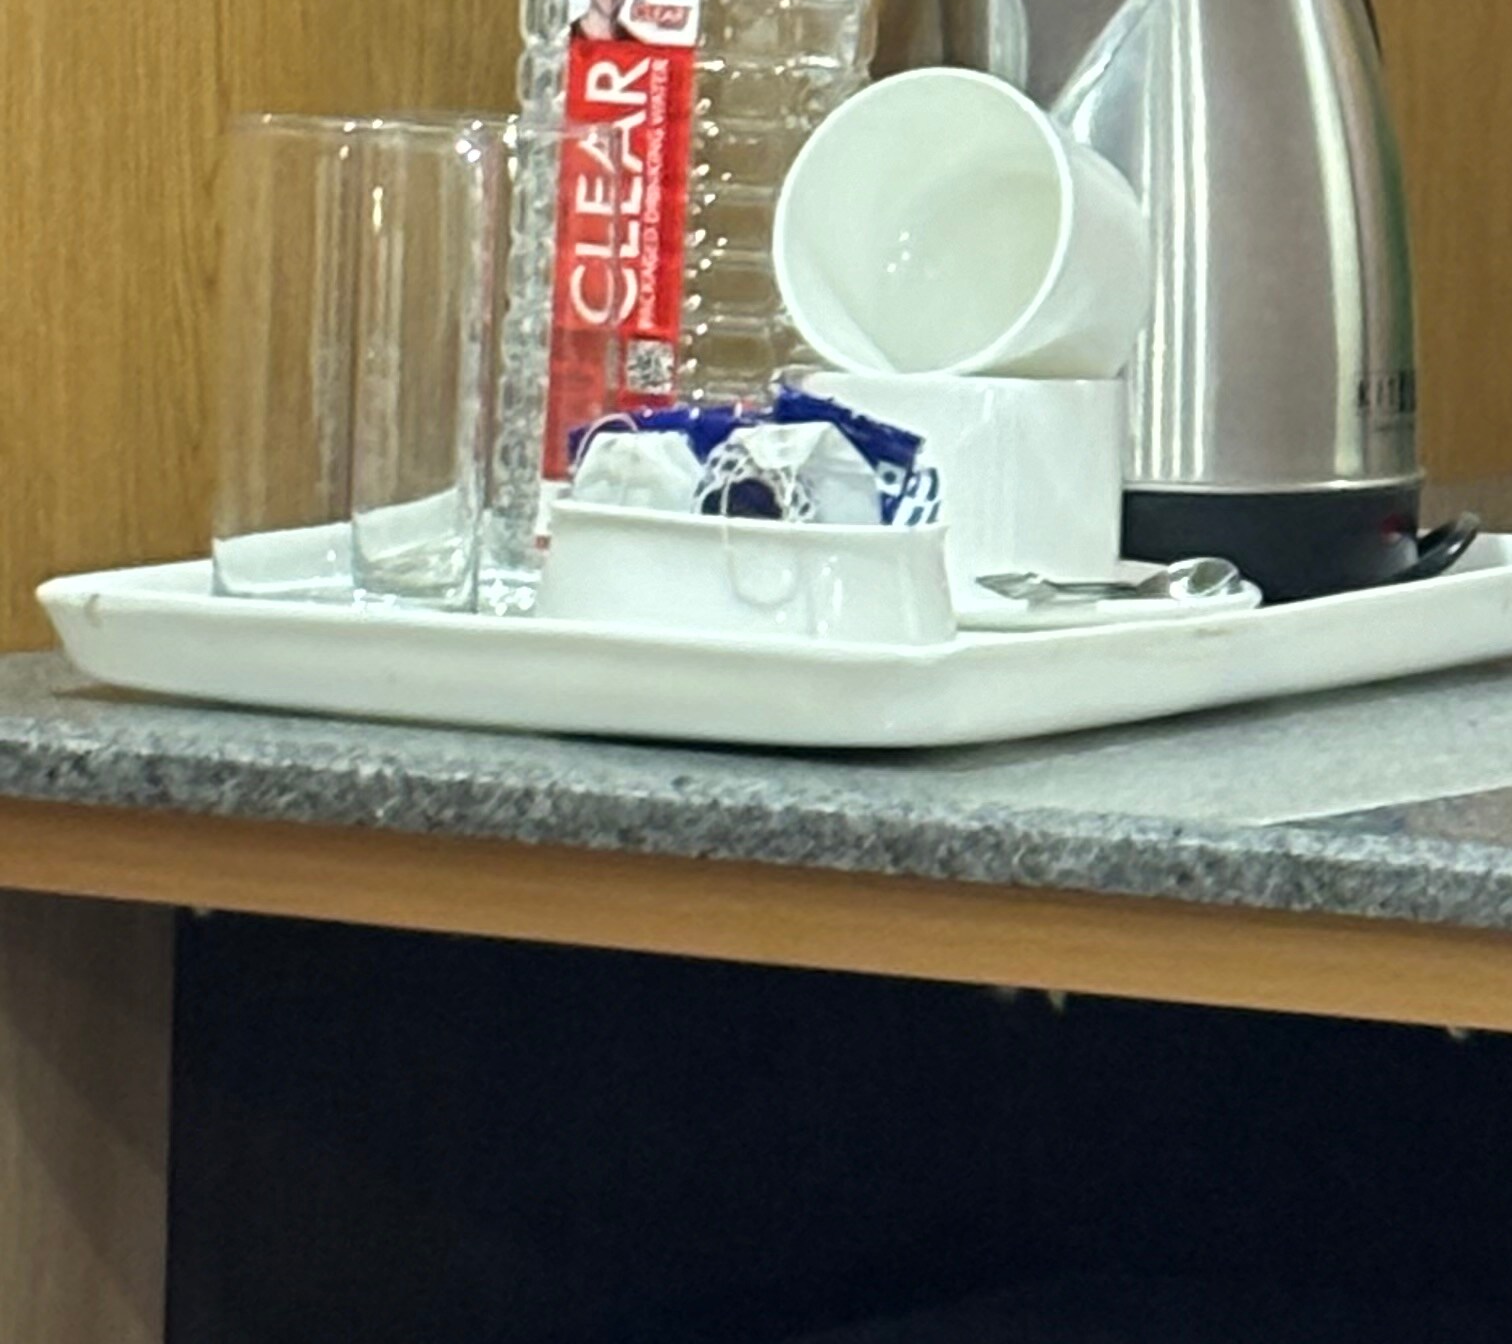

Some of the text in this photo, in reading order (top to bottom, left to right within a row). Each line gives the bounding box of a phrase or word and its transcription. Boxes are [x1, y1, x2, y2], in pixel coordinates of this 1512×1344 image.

[569, 57, 651, 325] CLEAR
[637, 58, 669, 330] PACKAGED DRINKING WATER
